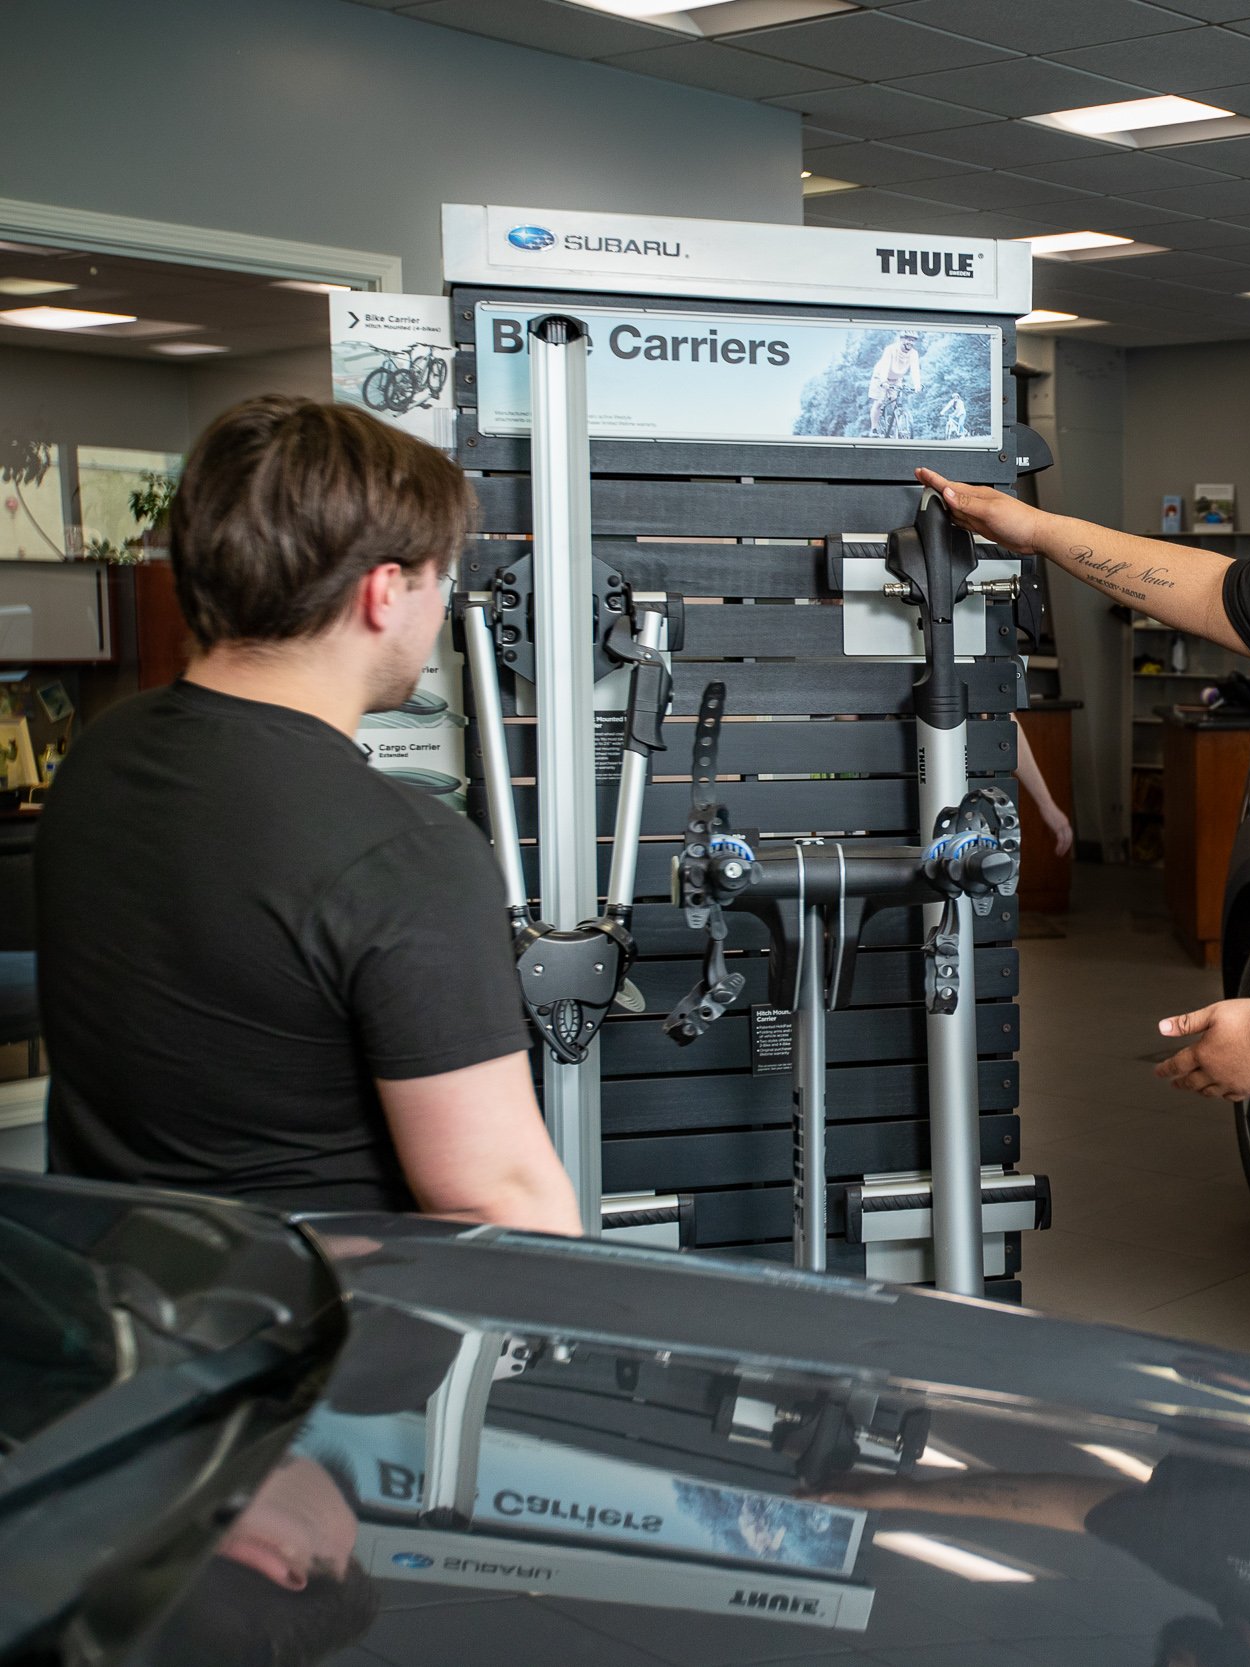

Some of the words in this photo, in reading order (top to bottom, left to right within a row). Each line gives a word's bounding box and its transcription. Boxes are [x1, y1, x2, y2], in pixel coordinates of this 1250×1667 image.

[564, 234, 680, 257] SUBARU
[876, 248, 974, 278] THULE
[365, 313, 385, 323] Bike
[388, 315, 421, 325] Carrier
[609, 323, 790, 367] Carriers
[1069, 545, 1132, 579] Rudolf
[378, 744, 407, 752] Cargo
[409, 743, 441, 751] Carrier
[918, 747, 927, 785] THULE
